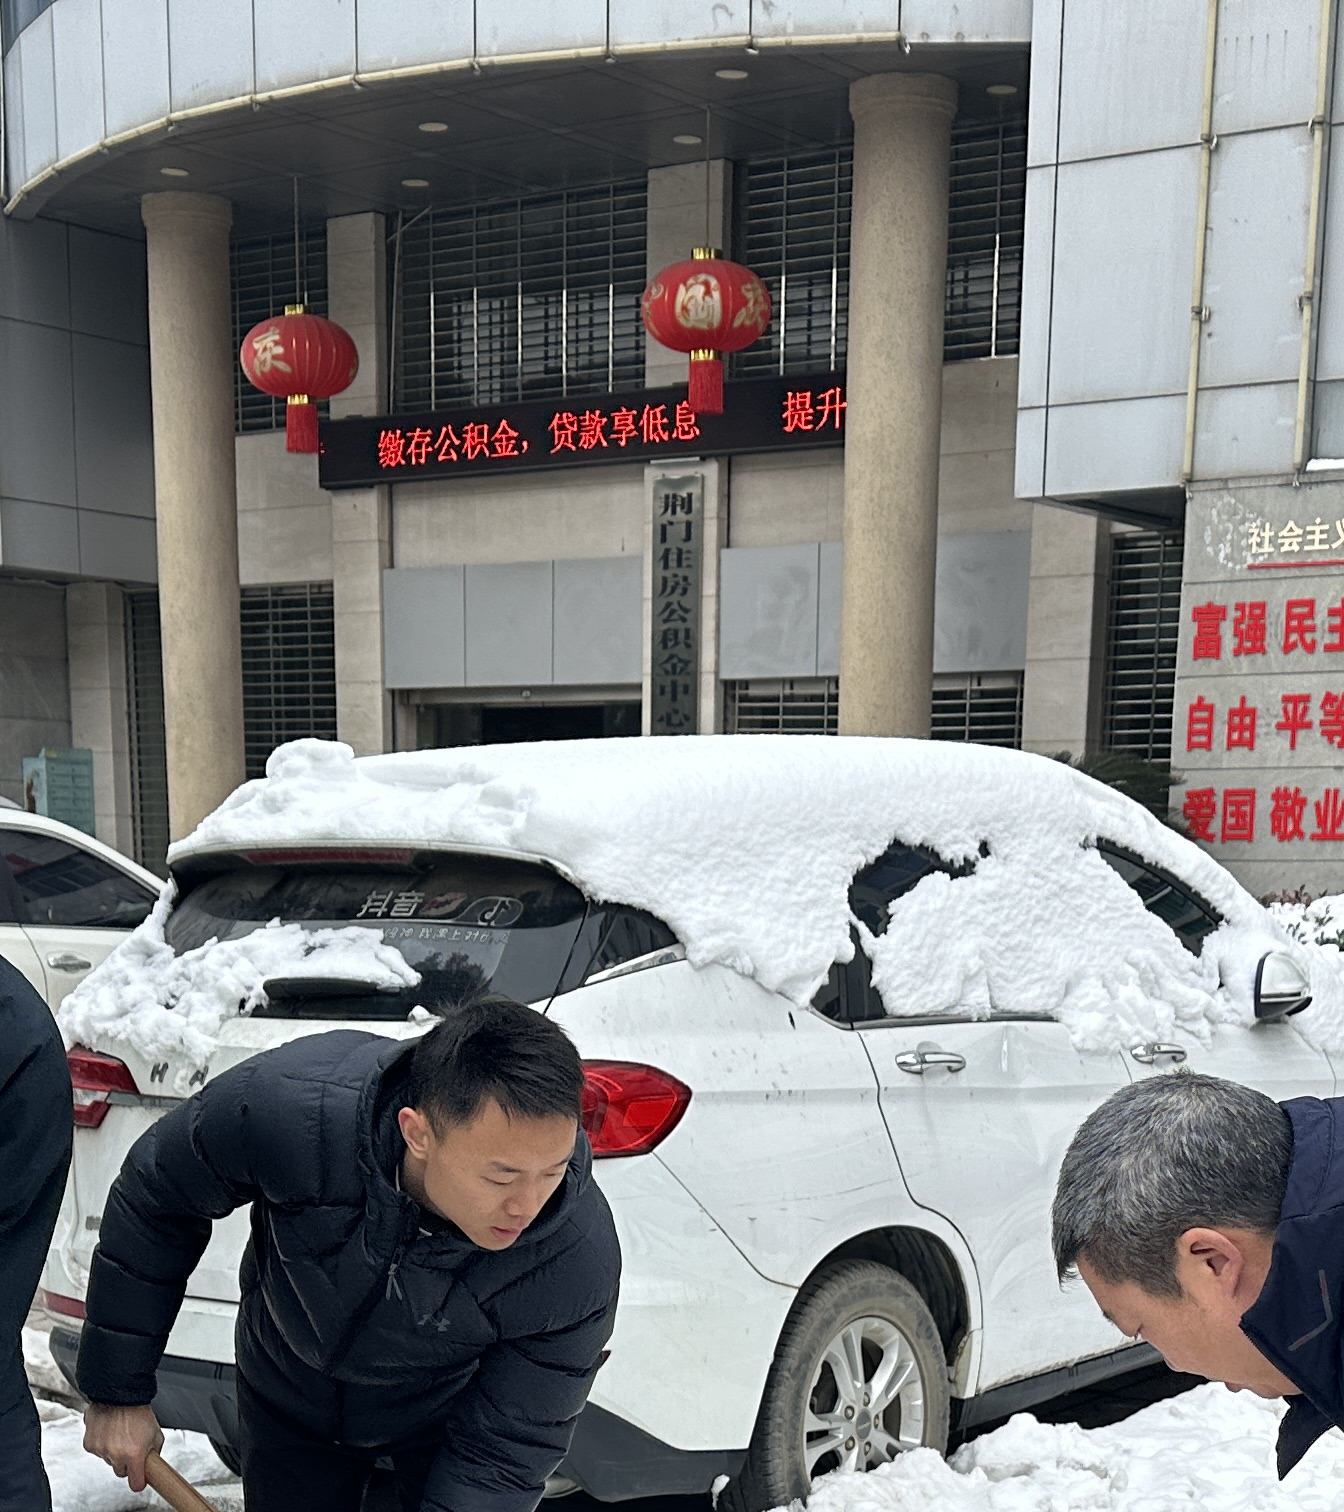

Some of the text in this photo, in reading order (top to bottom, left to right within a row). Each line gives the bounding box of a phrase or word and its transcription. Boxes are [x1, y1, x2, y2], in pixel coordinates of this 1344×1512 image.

[781, 386, 848, 435] 提升
[657, 492, 694, 728] 荆门住房公积金中心
[356, 890, 425, 917] 抖音
